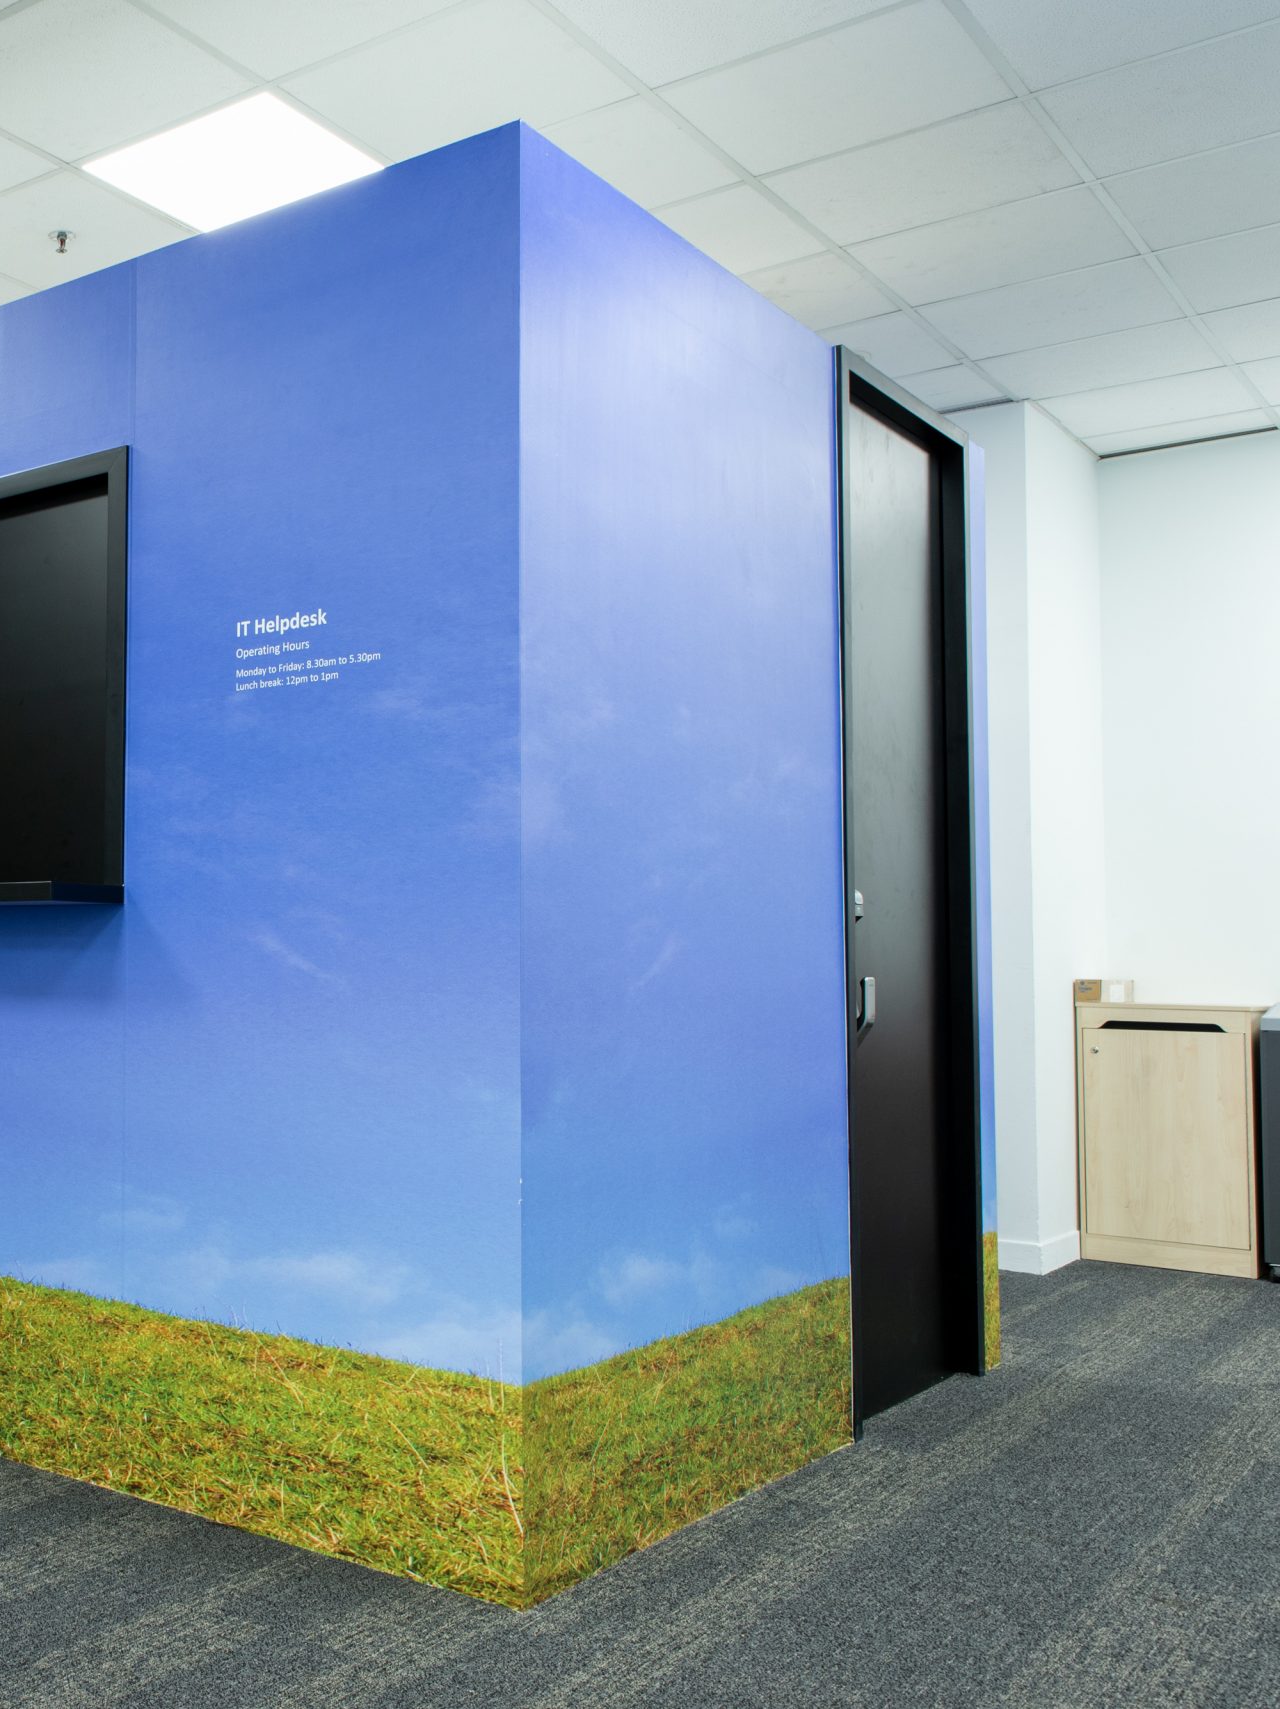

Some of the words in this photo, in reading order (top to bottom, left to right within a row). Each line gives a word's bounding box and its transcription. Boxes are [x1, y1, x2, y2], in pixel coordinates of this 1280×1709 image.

[236, 620, 251, 638] IT
[254, 608, 327, 635] Helpdesk
[235, 644, 281, 660] Operating
[282, 640, 310, 653] Hours
[235, 666, 267, 679] Monday
[268, 665, 277, 674] to
[278, 661, 305, 672] Friday:
[306, 658, 337, 669] 8.30am
[338, 656, 348, 665] to
[349, 652, 381, 664] 5.30pm
[235, 680, 259, 692] Lunch
[259, 677, 284, 689] break:
[286, 675, 309, 687] 12pm
[310, 673, 319, 682] to
[320, 671, 339, 683] 1pm
